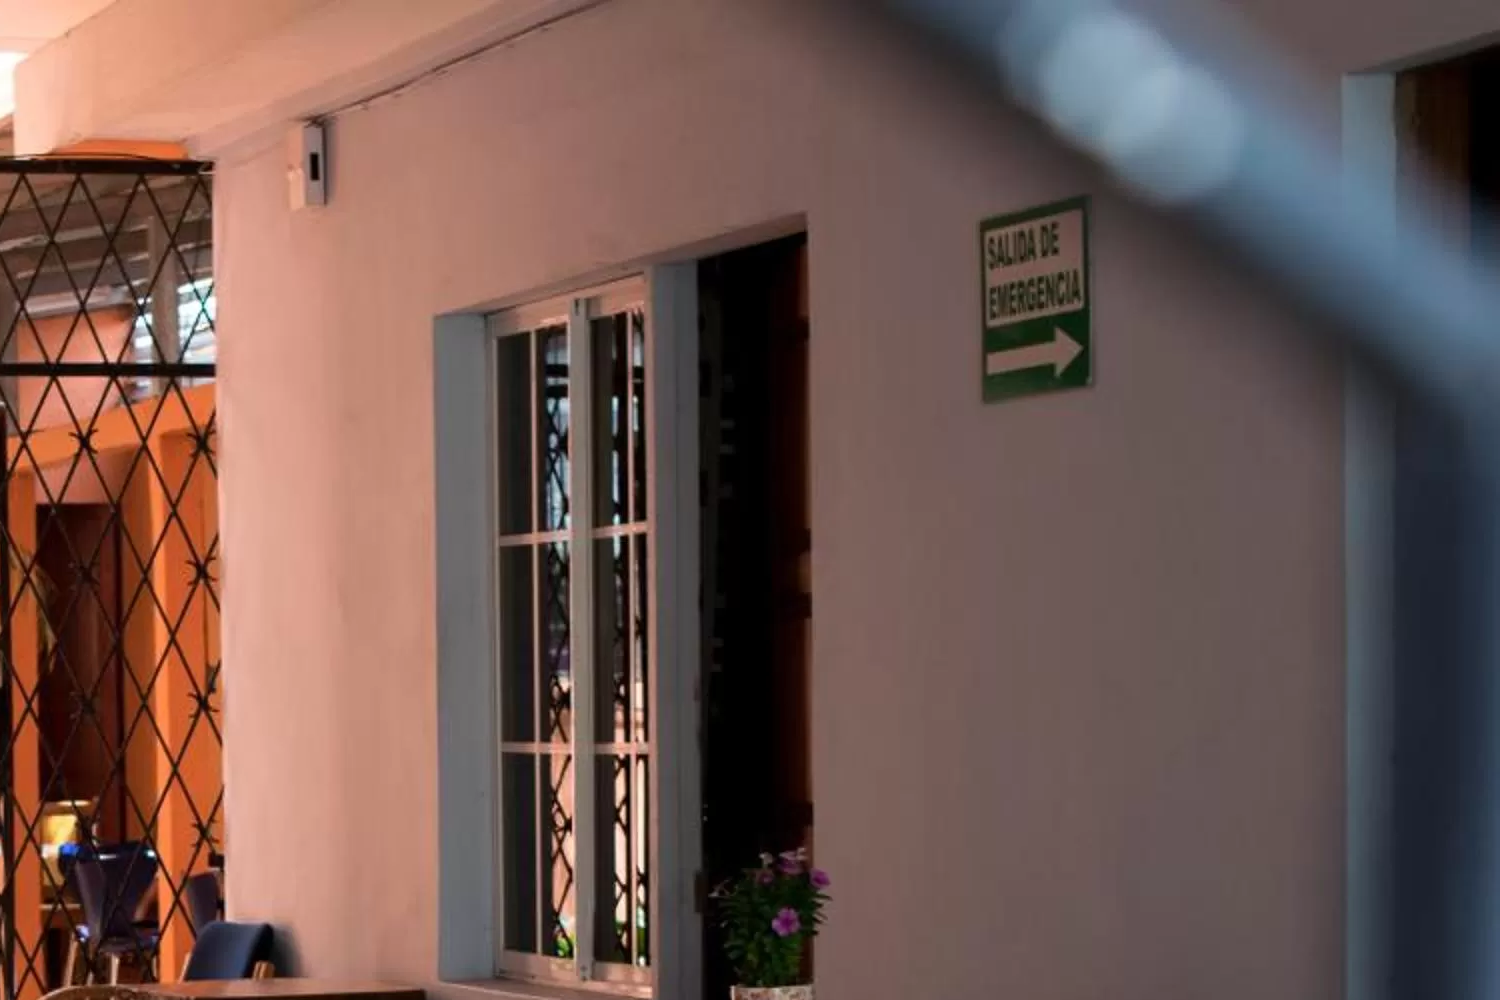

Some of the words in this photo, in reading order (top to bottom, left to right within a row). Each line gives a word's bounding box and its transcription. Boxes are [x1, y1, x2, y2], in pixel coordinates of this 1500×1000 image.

[988, 228, 1037, 270] SALIDA
[1040, 221, 1061, 258] DE
[989, 268, 1082, 321] EMERGENCIA
